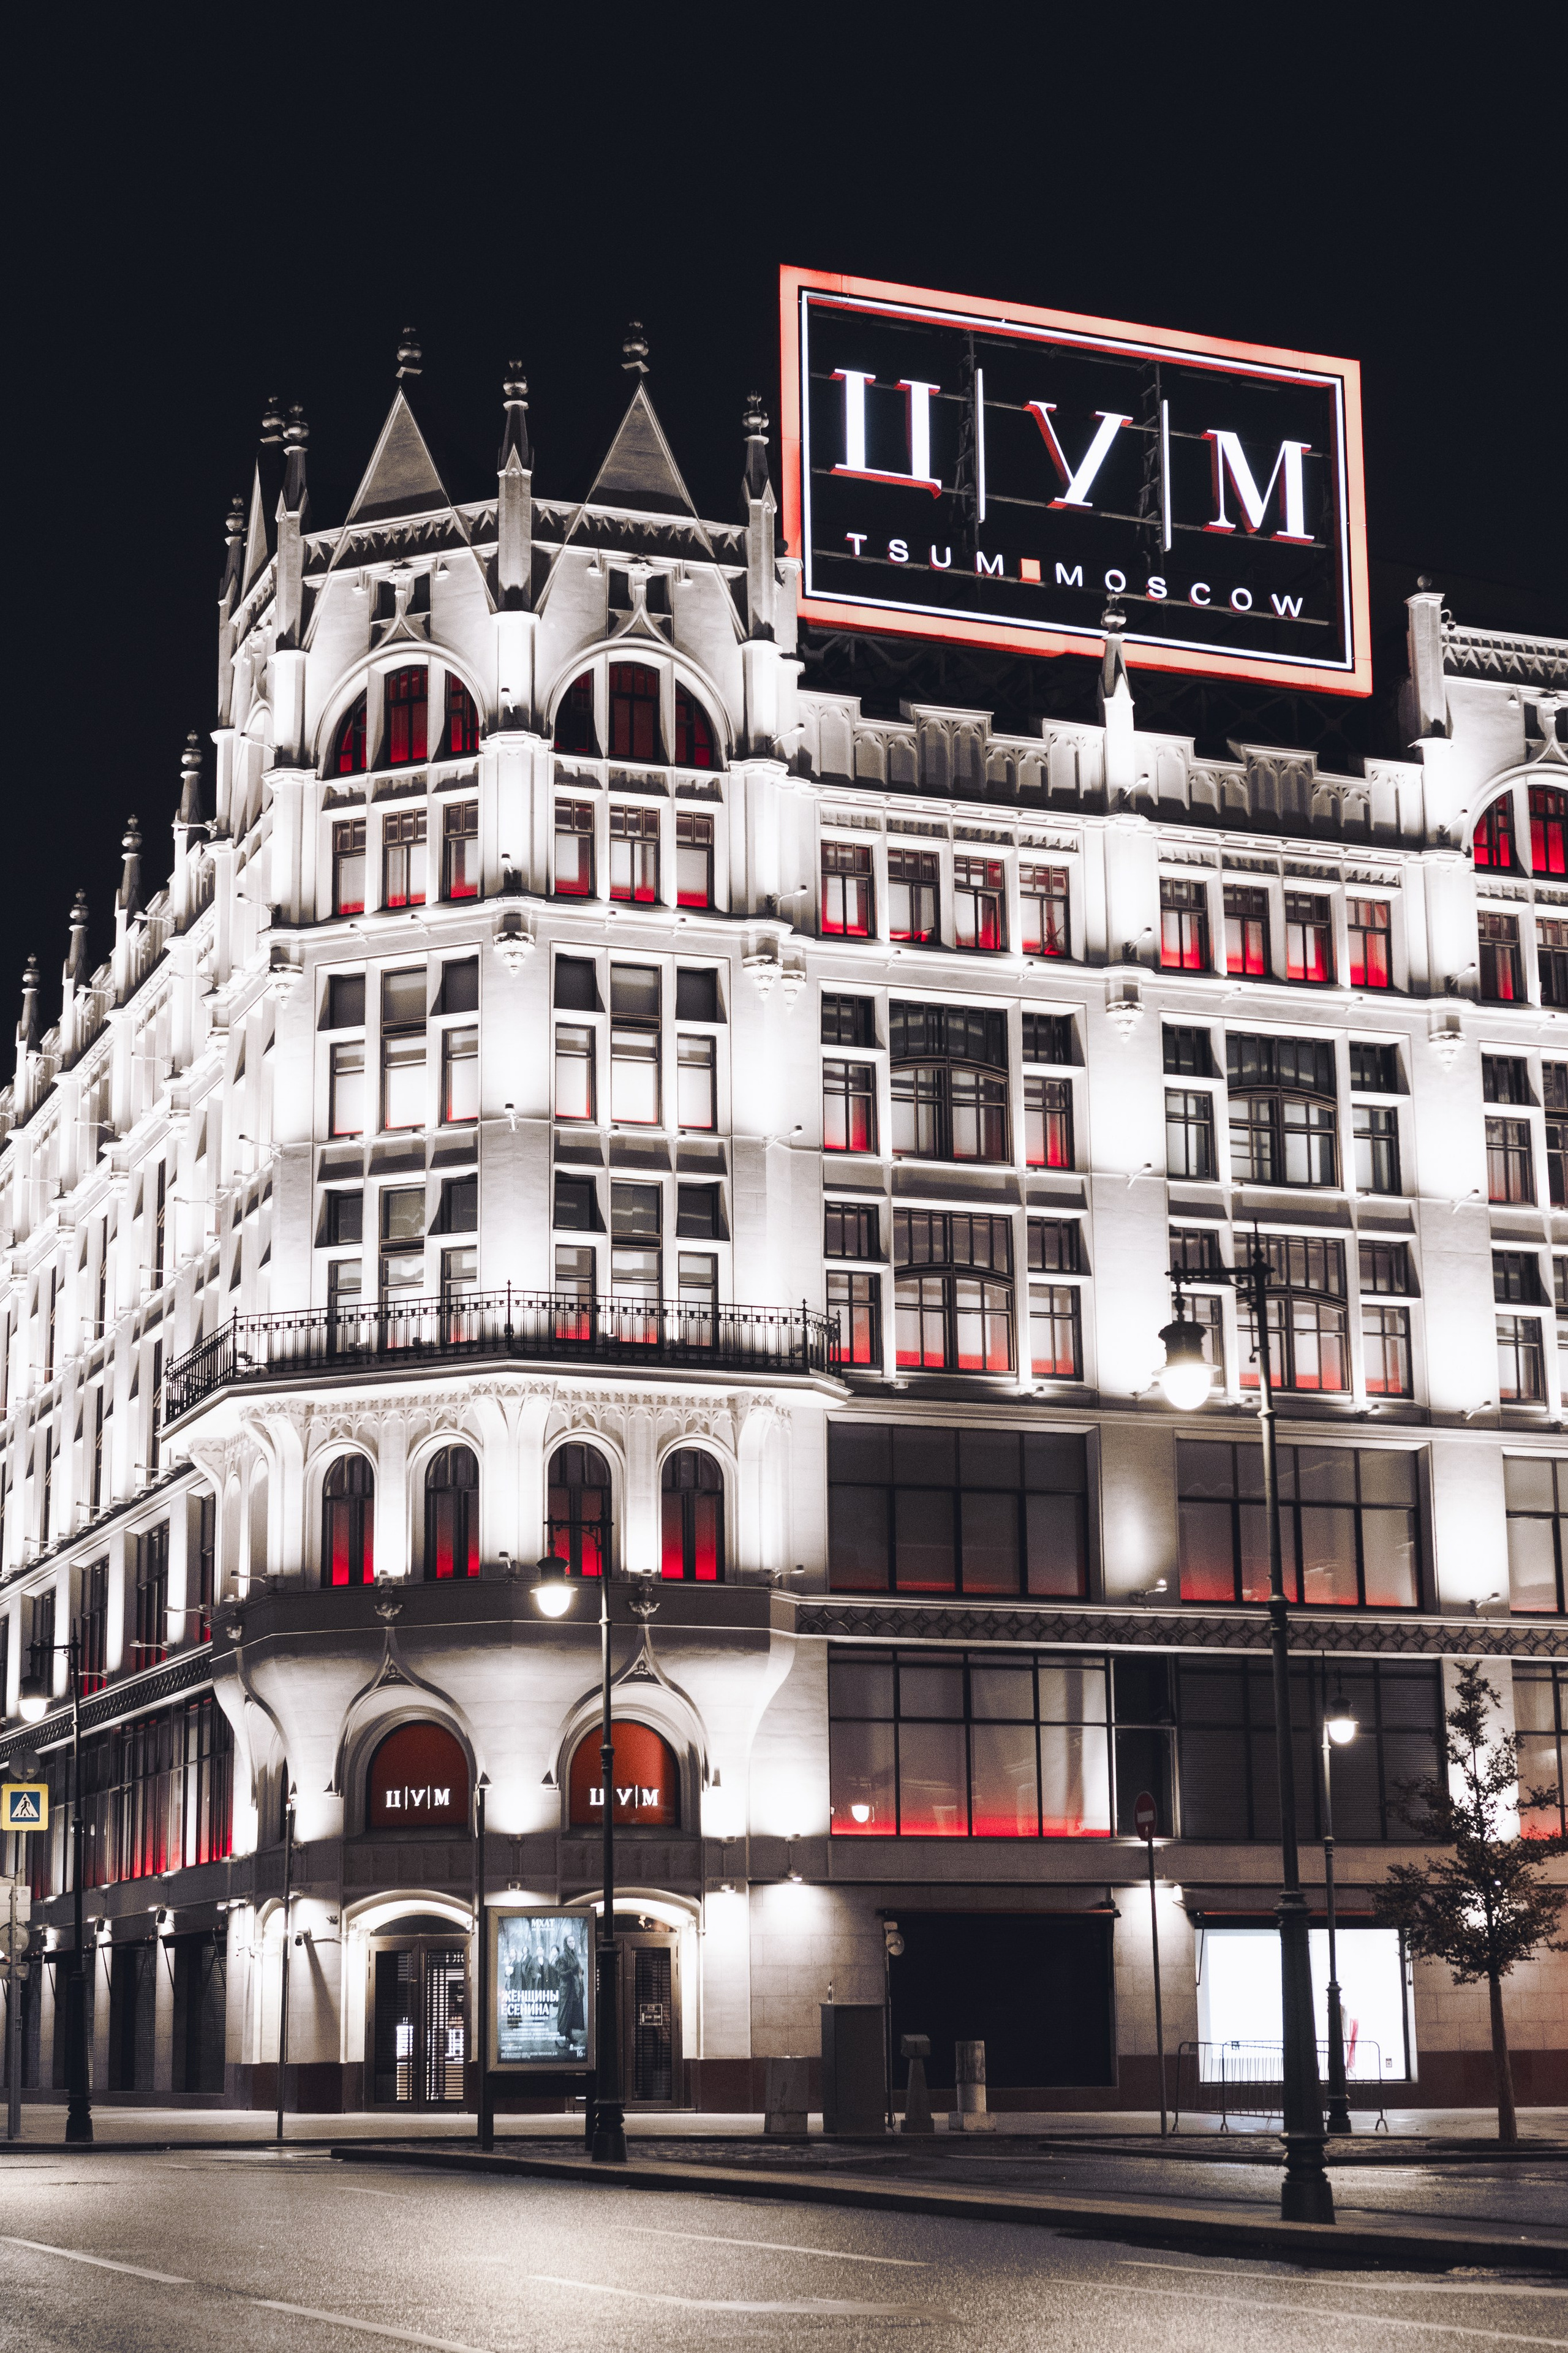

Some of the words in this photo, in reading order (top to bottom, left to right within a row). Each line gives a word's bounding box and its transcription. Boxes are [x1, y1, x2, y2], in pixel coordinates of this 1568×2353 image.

[845, 532, 1005, 577] TSUM
[1055, 562, 1304, 618] MOSCOW
[532, 1919, 555, 1928] МХАТ
[501, 1990, 559, 2003] ЖЕНЩИНЫ
[501, 2003, 549, 2015] ЕСЕНИНА
